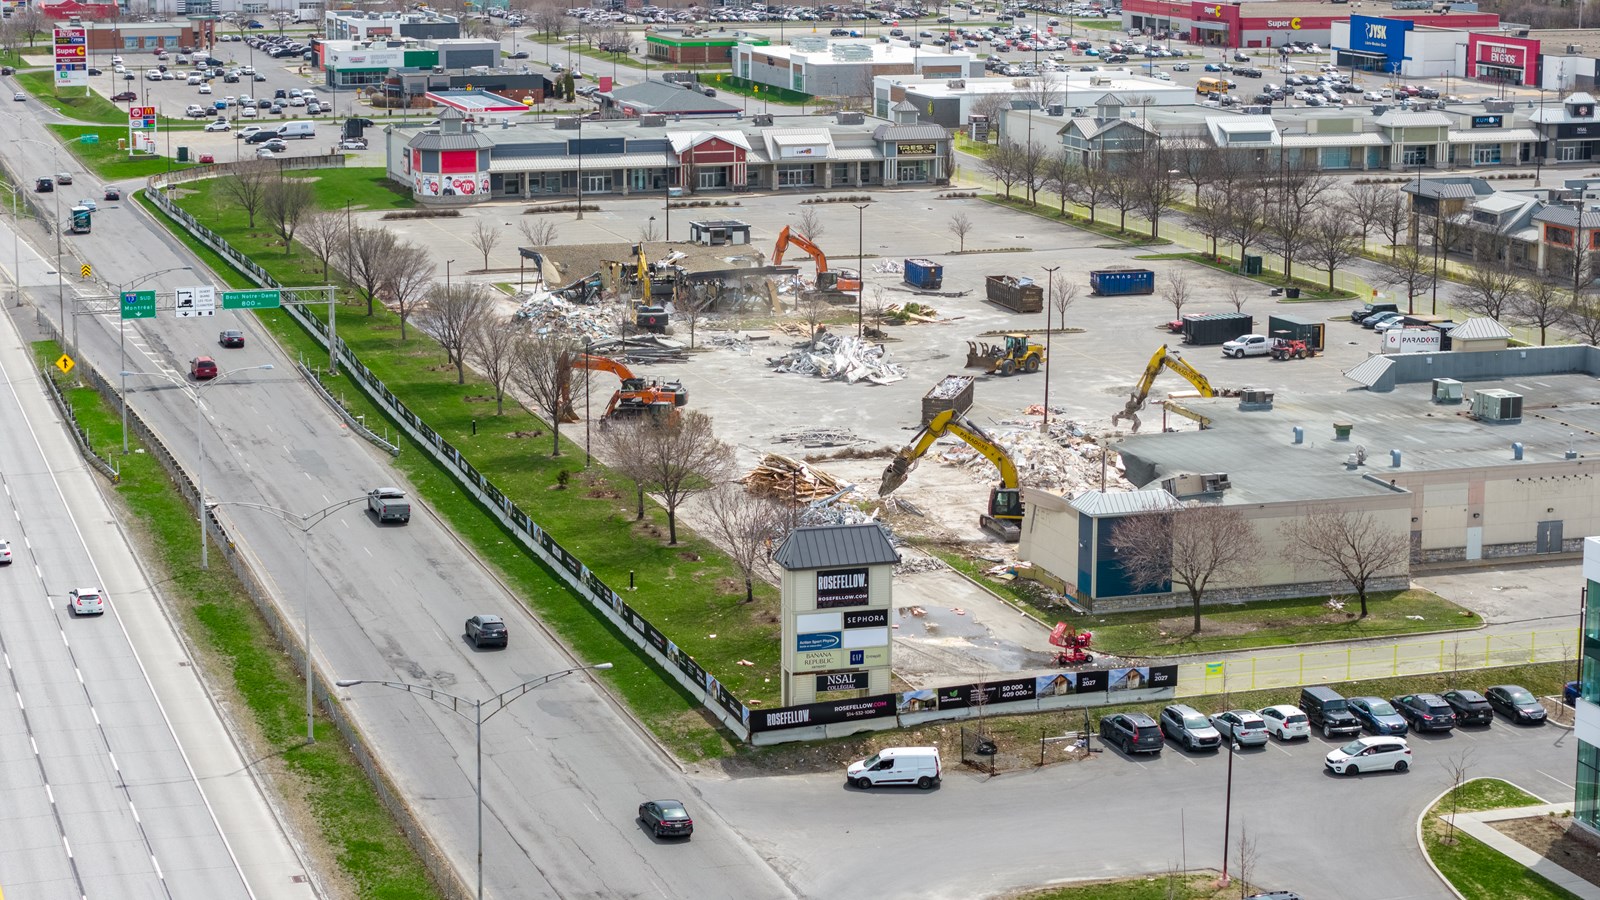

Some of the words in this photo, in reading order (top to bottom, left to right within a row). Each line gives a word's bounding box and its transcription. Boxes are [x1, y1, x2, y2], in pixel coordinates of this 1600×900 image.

[1204, 6, 1216, 14] Super
[1215, 5, 1221, 17] C
[1267, 20, 1290, 28] Super
[1291, 17, 1301, 30] C
[1369, 24, 1387, 40] JYSK
[76, 46, 85, 56] C
[1491, 52, 1499, 62] EN
[1499, 54, 1516, 64] GROS
[818, 573, 868, 590] ROSEFELLOW.
[818, 594, 868, 602] ROSEFELLOW.COM
[847, 615, 885, 624] SEPHORA
[827, 674, 856, 685] NSAL
[767, 709, 812, 726] ROSEFELLOW.
[834, 701, 887, 712] ROSEFELLOW.COM
